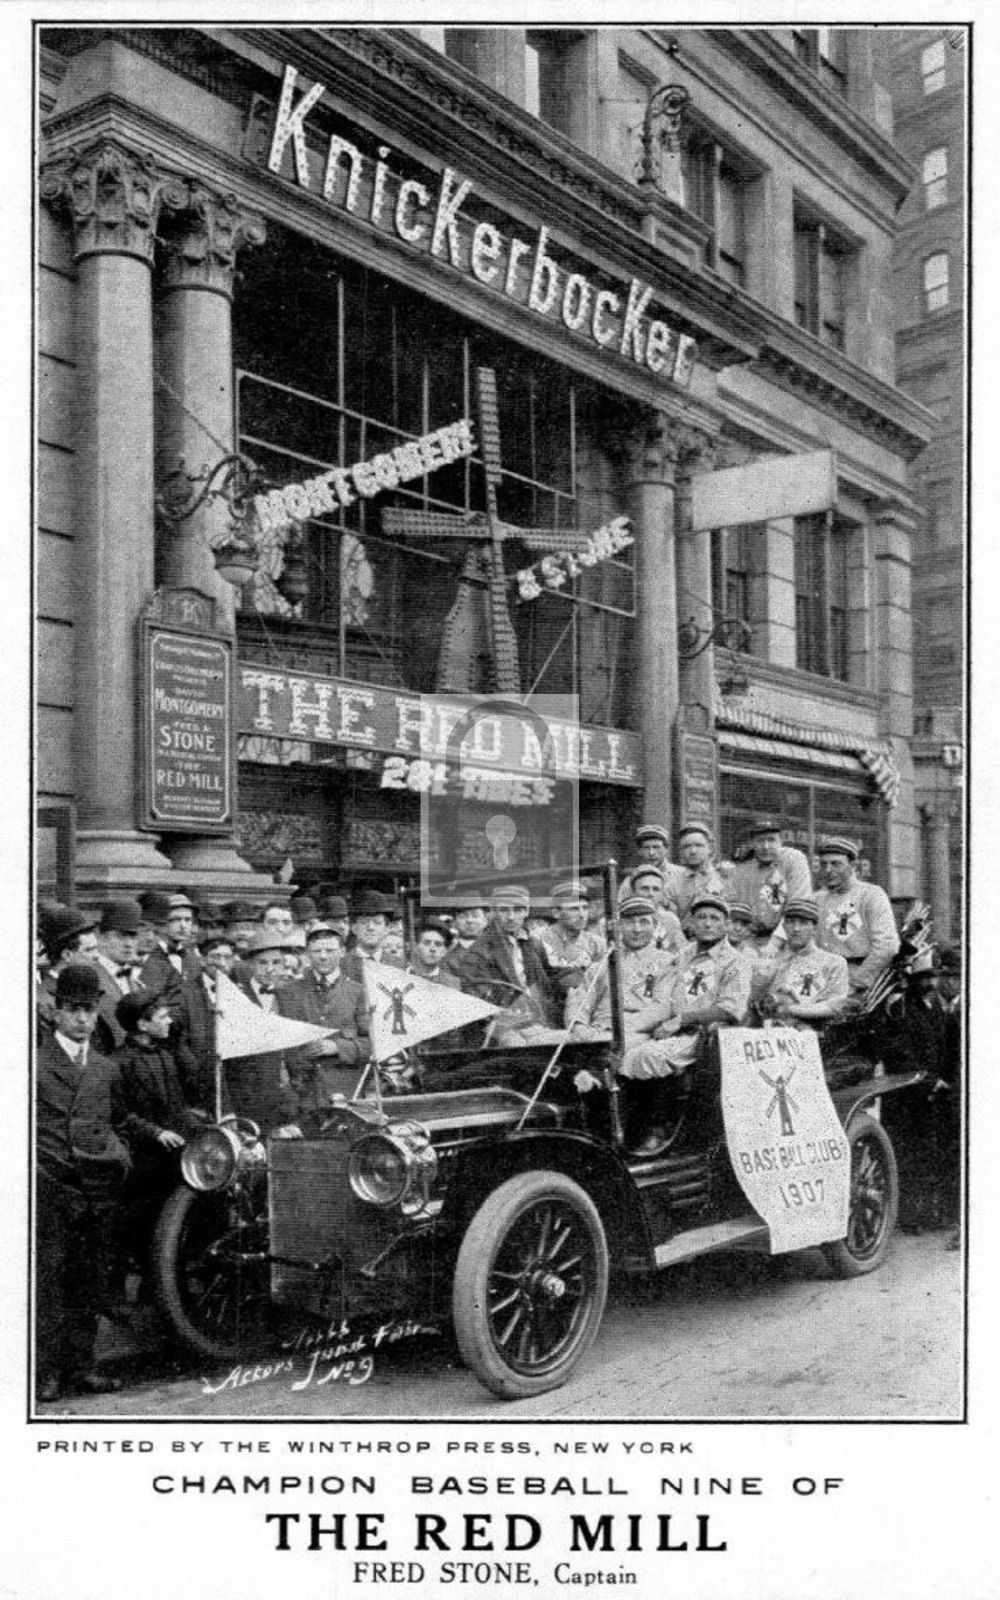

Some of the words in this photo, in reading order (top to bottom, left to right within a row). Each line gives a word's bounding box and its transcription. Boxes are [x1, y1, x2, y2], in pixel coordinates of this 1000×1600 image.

[241, 668, 376, 745] THE
[395, 696, 502, 763] RED
[160, 724, 217, 752] STONE
[156, 768, 186, 788] RED
[189, 772, 224, 792] MILL
[743, 1039, 775, 1063] RED
[778, 1179, 825, 1209] 1907
[203, 1358, 294, 1393] Actors
[372, 1319, 441, 1347] Fair
